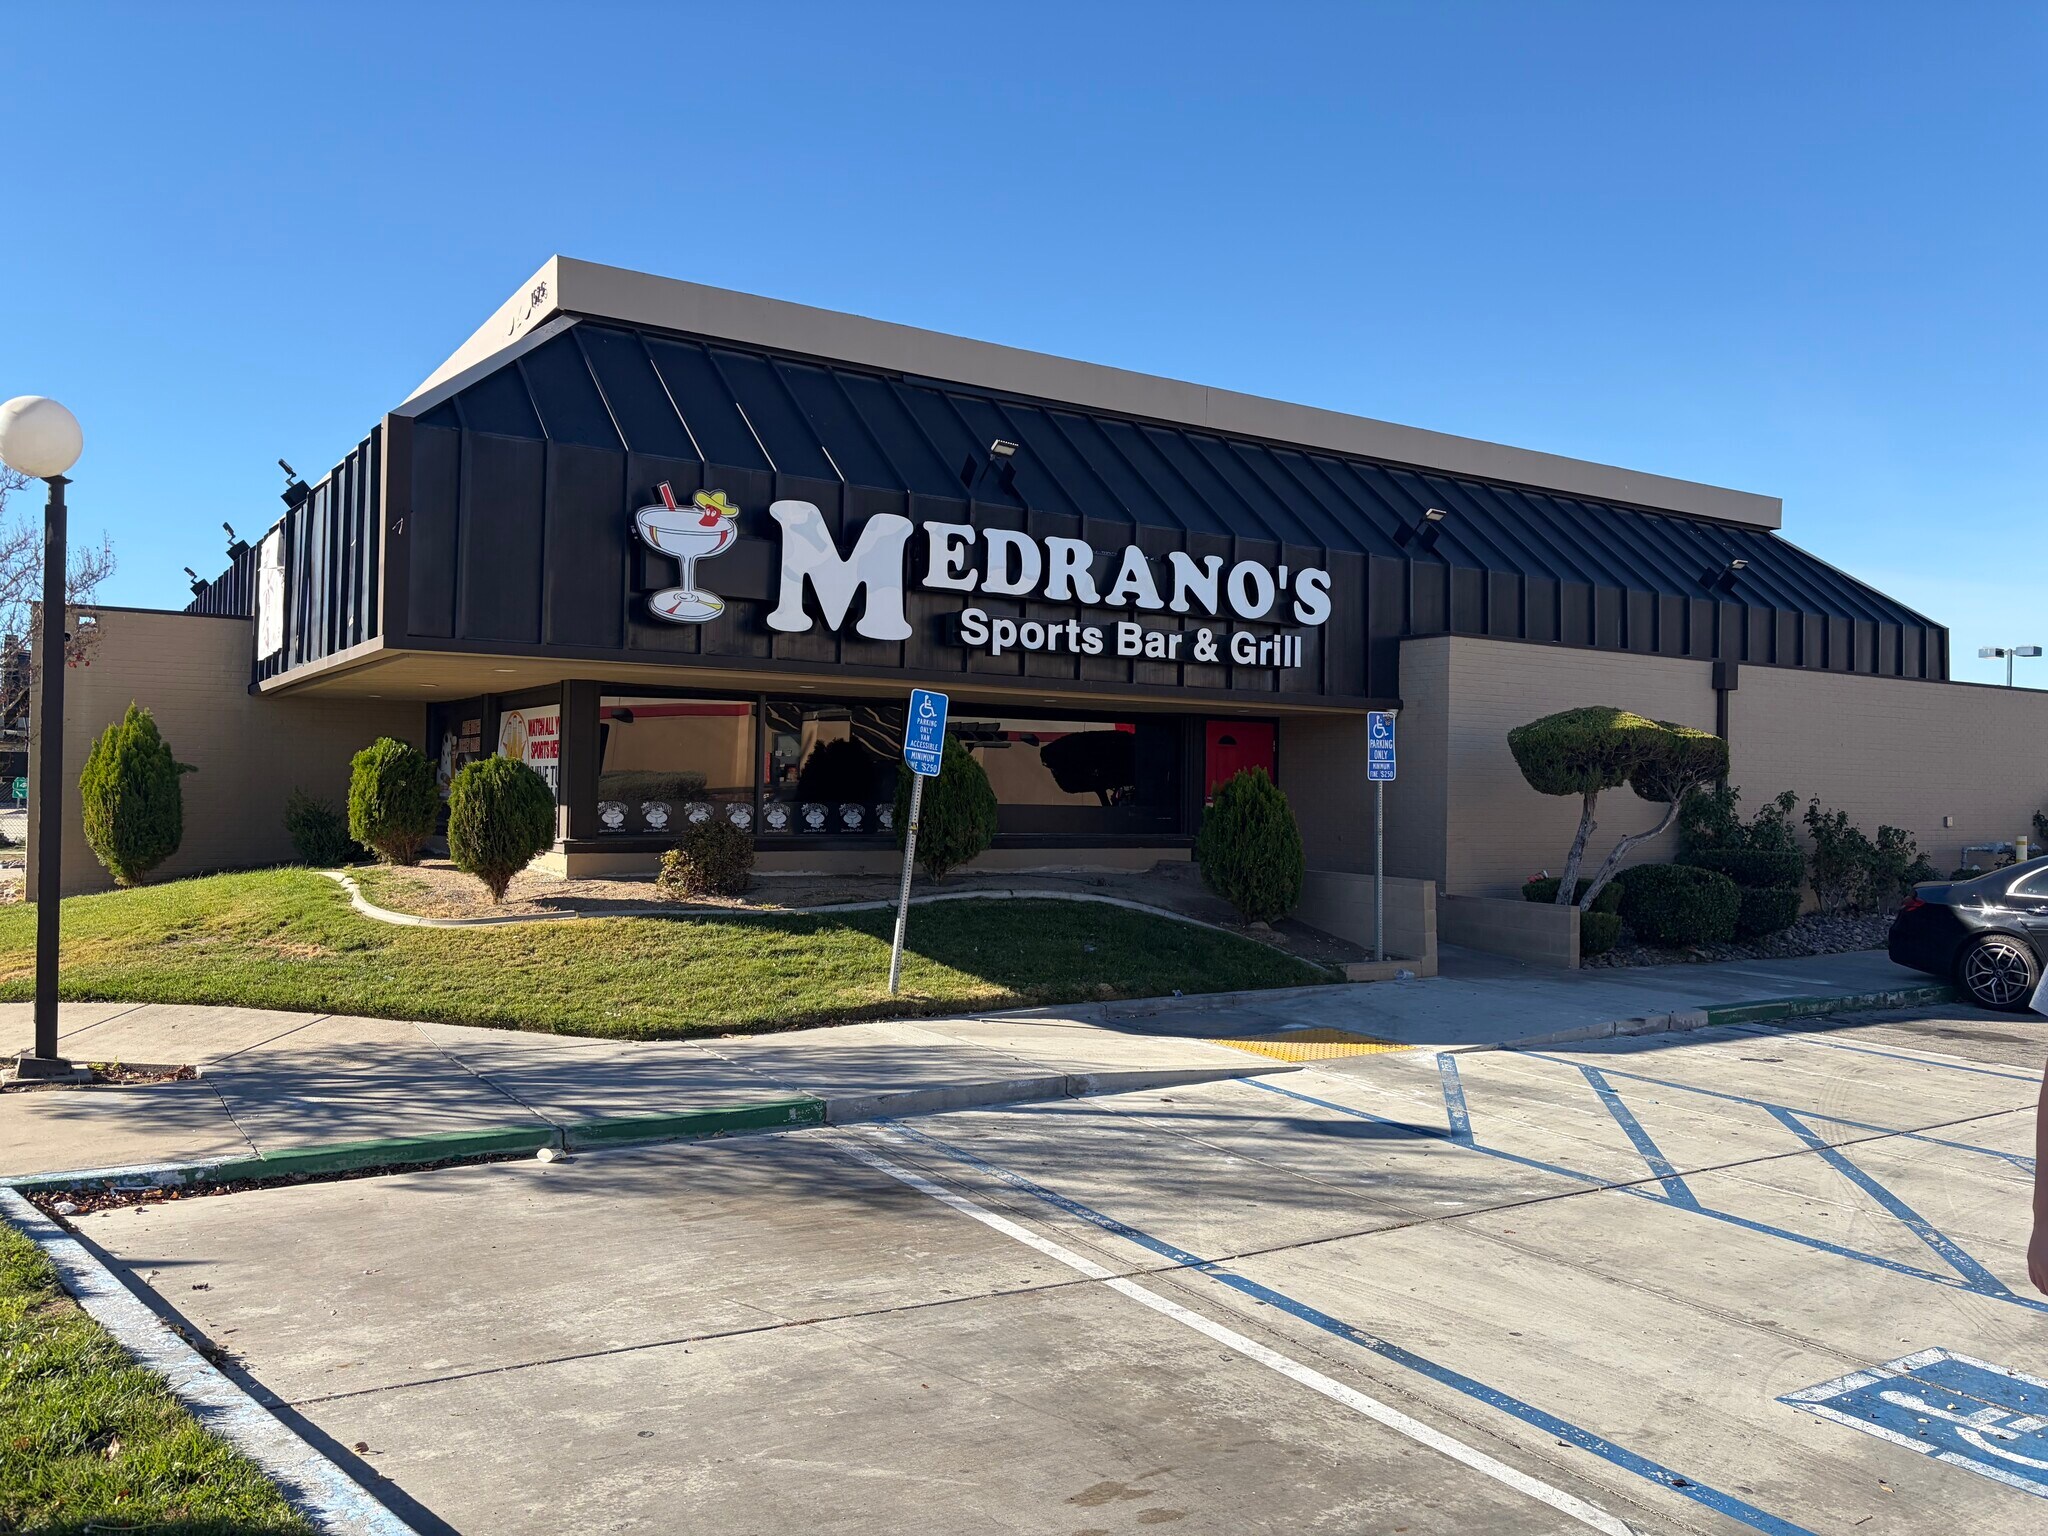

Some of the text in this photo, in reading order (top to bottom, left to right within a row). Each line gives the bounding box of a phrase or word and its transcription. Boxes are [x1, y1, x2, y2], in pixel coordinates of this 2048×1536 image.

[766, 500, 1332, 641] MEDRANO'S
[960, 607, 1302, 668] Sports Bar & Grill
[916, 717, 937, 728] PARKING
[920, 734, 930, 742] VAN
[910, 740, 938, 751] ACCESSIBLE
[1370, 739, 1393, 749] PARKING
[910, 751, 935, 762] MINIMUM
[1374, 750, 1388, 760] ONLY
[921, 761, 937, 773] $250
